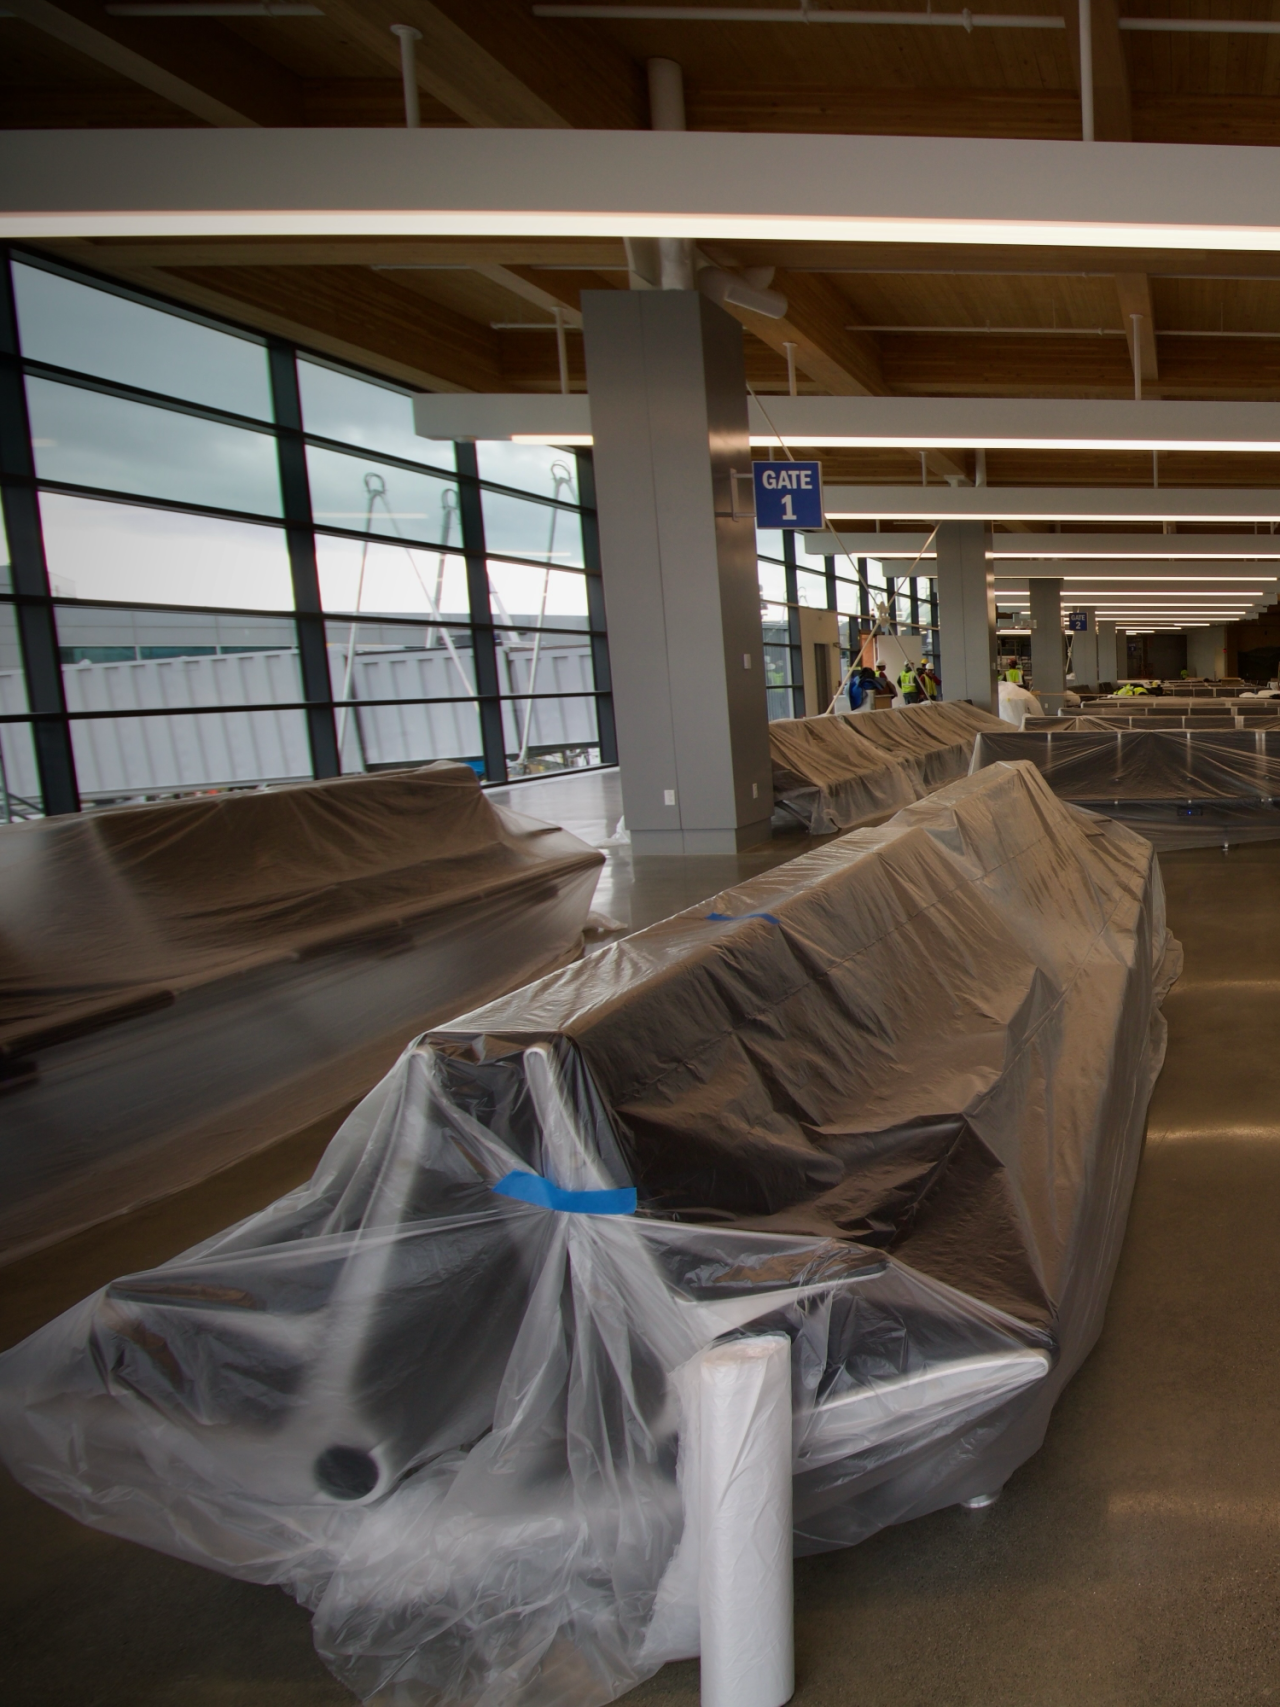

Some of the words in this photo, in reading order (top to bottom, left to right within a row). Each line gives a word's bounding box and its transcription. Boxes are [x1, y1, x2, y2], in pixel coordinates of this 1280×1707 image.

[762, 470, 813, 490] GATE
[781, 494, 797, 521] 1
[1076, 621, 1081, 630] 2
